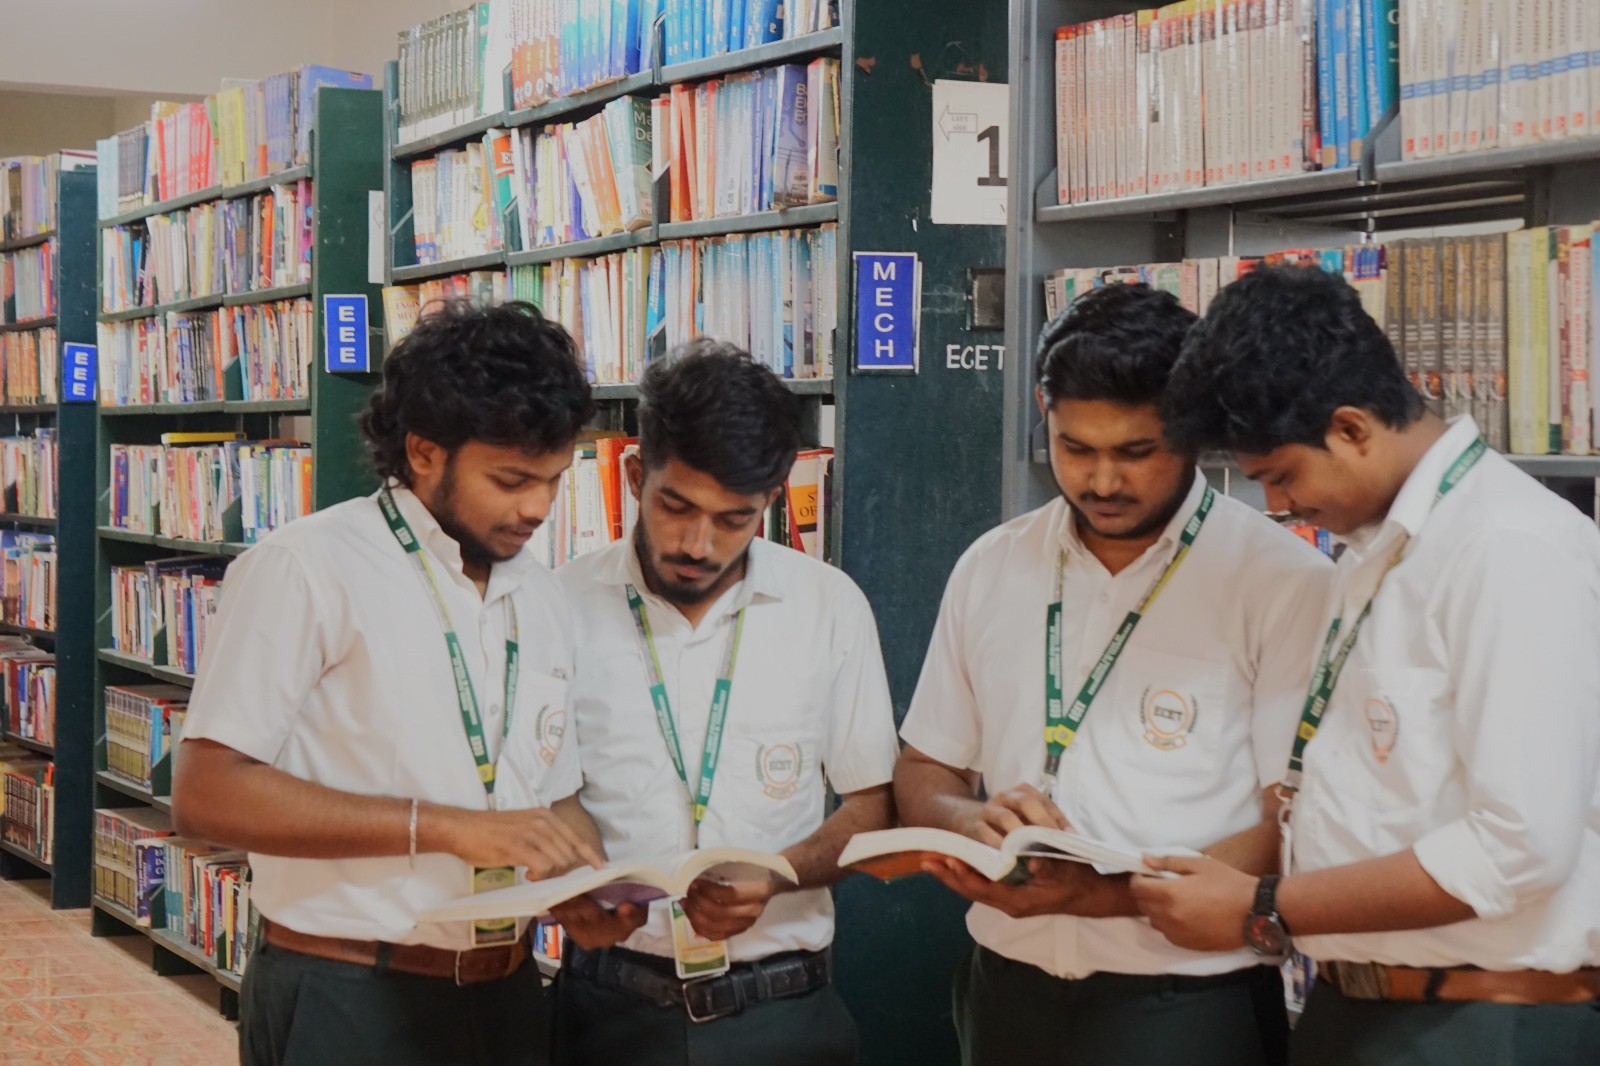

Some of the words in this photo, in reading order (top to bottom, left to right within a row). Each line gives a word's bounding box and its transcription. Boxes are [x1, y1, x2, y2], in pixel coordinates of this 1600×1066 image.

[977, 126, 1007, 186] 1
[339, 306, 356, 363] EEE
[873, 261, 896, 358] MECH
[73, 352, 88, 396] EEE
[946, 344, 1005, 370] ECET
